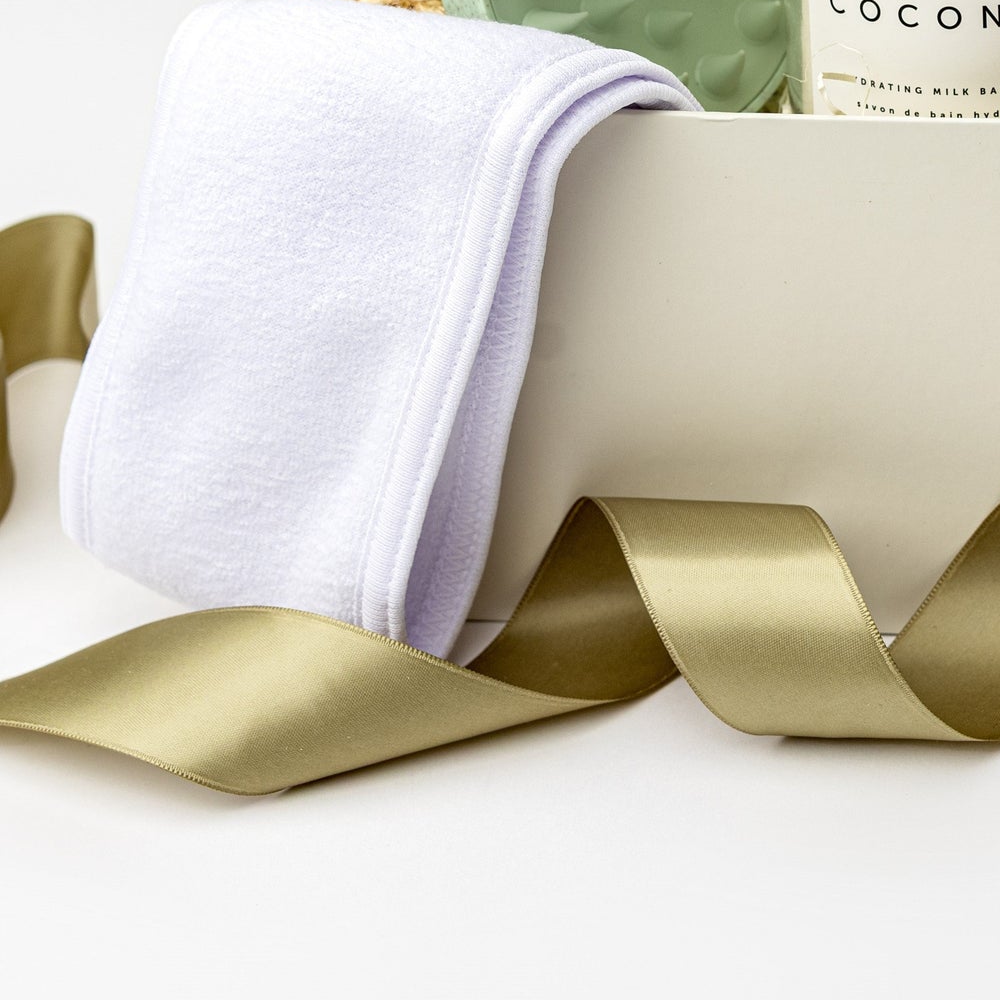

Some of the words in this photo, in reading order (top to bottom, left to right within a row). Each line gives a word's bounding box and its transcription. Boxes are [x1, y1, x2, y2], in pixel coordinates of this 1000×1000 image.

[855, 76, 923, 95] DRATING
[933, 87, 969, 96] MILK
[904, 109, 920, 118] de
